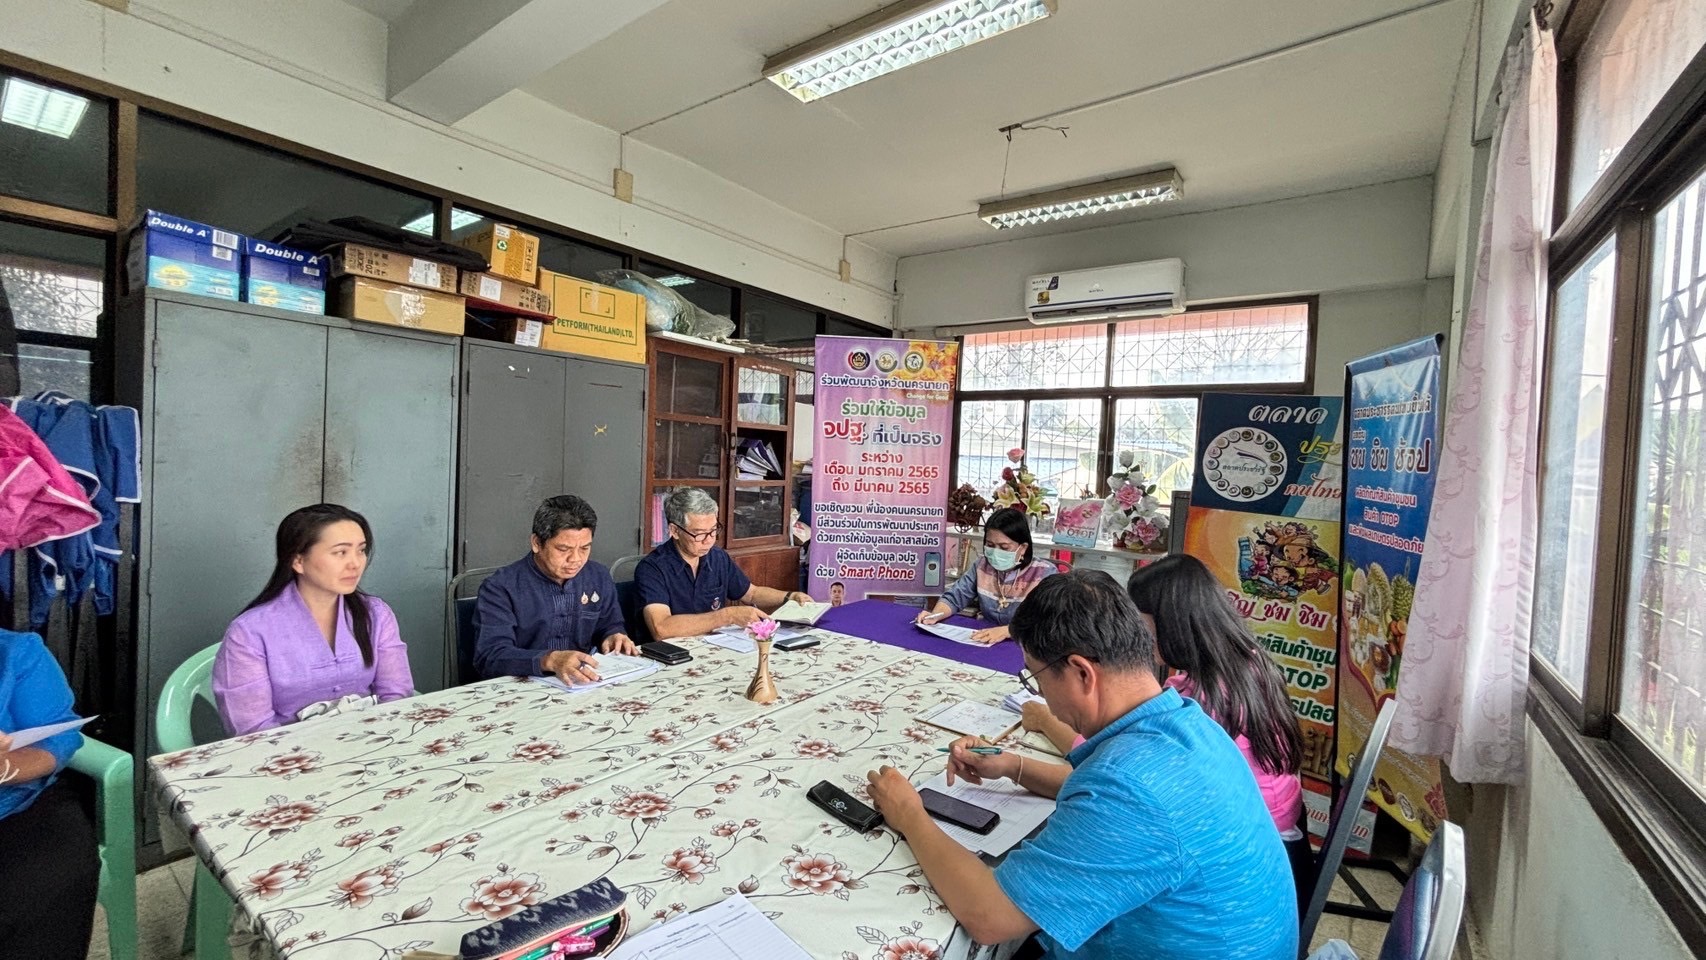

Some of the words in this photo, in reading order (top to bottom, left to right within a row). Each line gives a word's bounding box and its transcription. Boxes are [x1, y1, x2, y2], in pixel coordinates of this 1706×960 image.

[150, 216, 194, 235] Double
[196, 229, 207, 238] A
[255, 243, 304, 261] Double
[307, 255, 319, 265] A
[821, 374, 950, 391] ร่วมพัฒนาจังหวัดนครนายก
[841, 398, 926, 423] ร่วมให้ข้อมูล
[1248, 404, 1329, 425] ตลาด
[872, 423, 942, 446] ที่เป็นจริง
[861, 450, 903, 464] ระหว่าง
[1394, 439, 1431, 473] ช้อป
[824, 461, 854, 477] เดือน
[858, 465, 904, 478] มกราคม
[908, 465, 939, 478] 2565
[832, 478, 849, 492] ถึง
[854, 478, 894, 494] มีนาคม
[898, 481, 930, 495] 2565
[814, 502, 864, 514] ขอเชิญชวน
[866, 500, 944, 516] พี่น้องคนนครนายก
[817, 516, 939, 532] มีส่วนร่วมในการพัฒนาประเทศ
[1381, 511, 1399, 527] OTOP
[816, 531, 939, 548] ด้วยการให้ข้อมูลแก่อาสาสมัคร
[836, 548, 895, 566] ผู้จัดเก็บข้อมูล
[815, 564, 835, 577] ด้วย
[839, 565, 875, 579] Smart
[877, 567, 915, 580] Phone
[1264, 601, 1291, 621] ชม
[1299, 604, 1328, 628] ชิม
